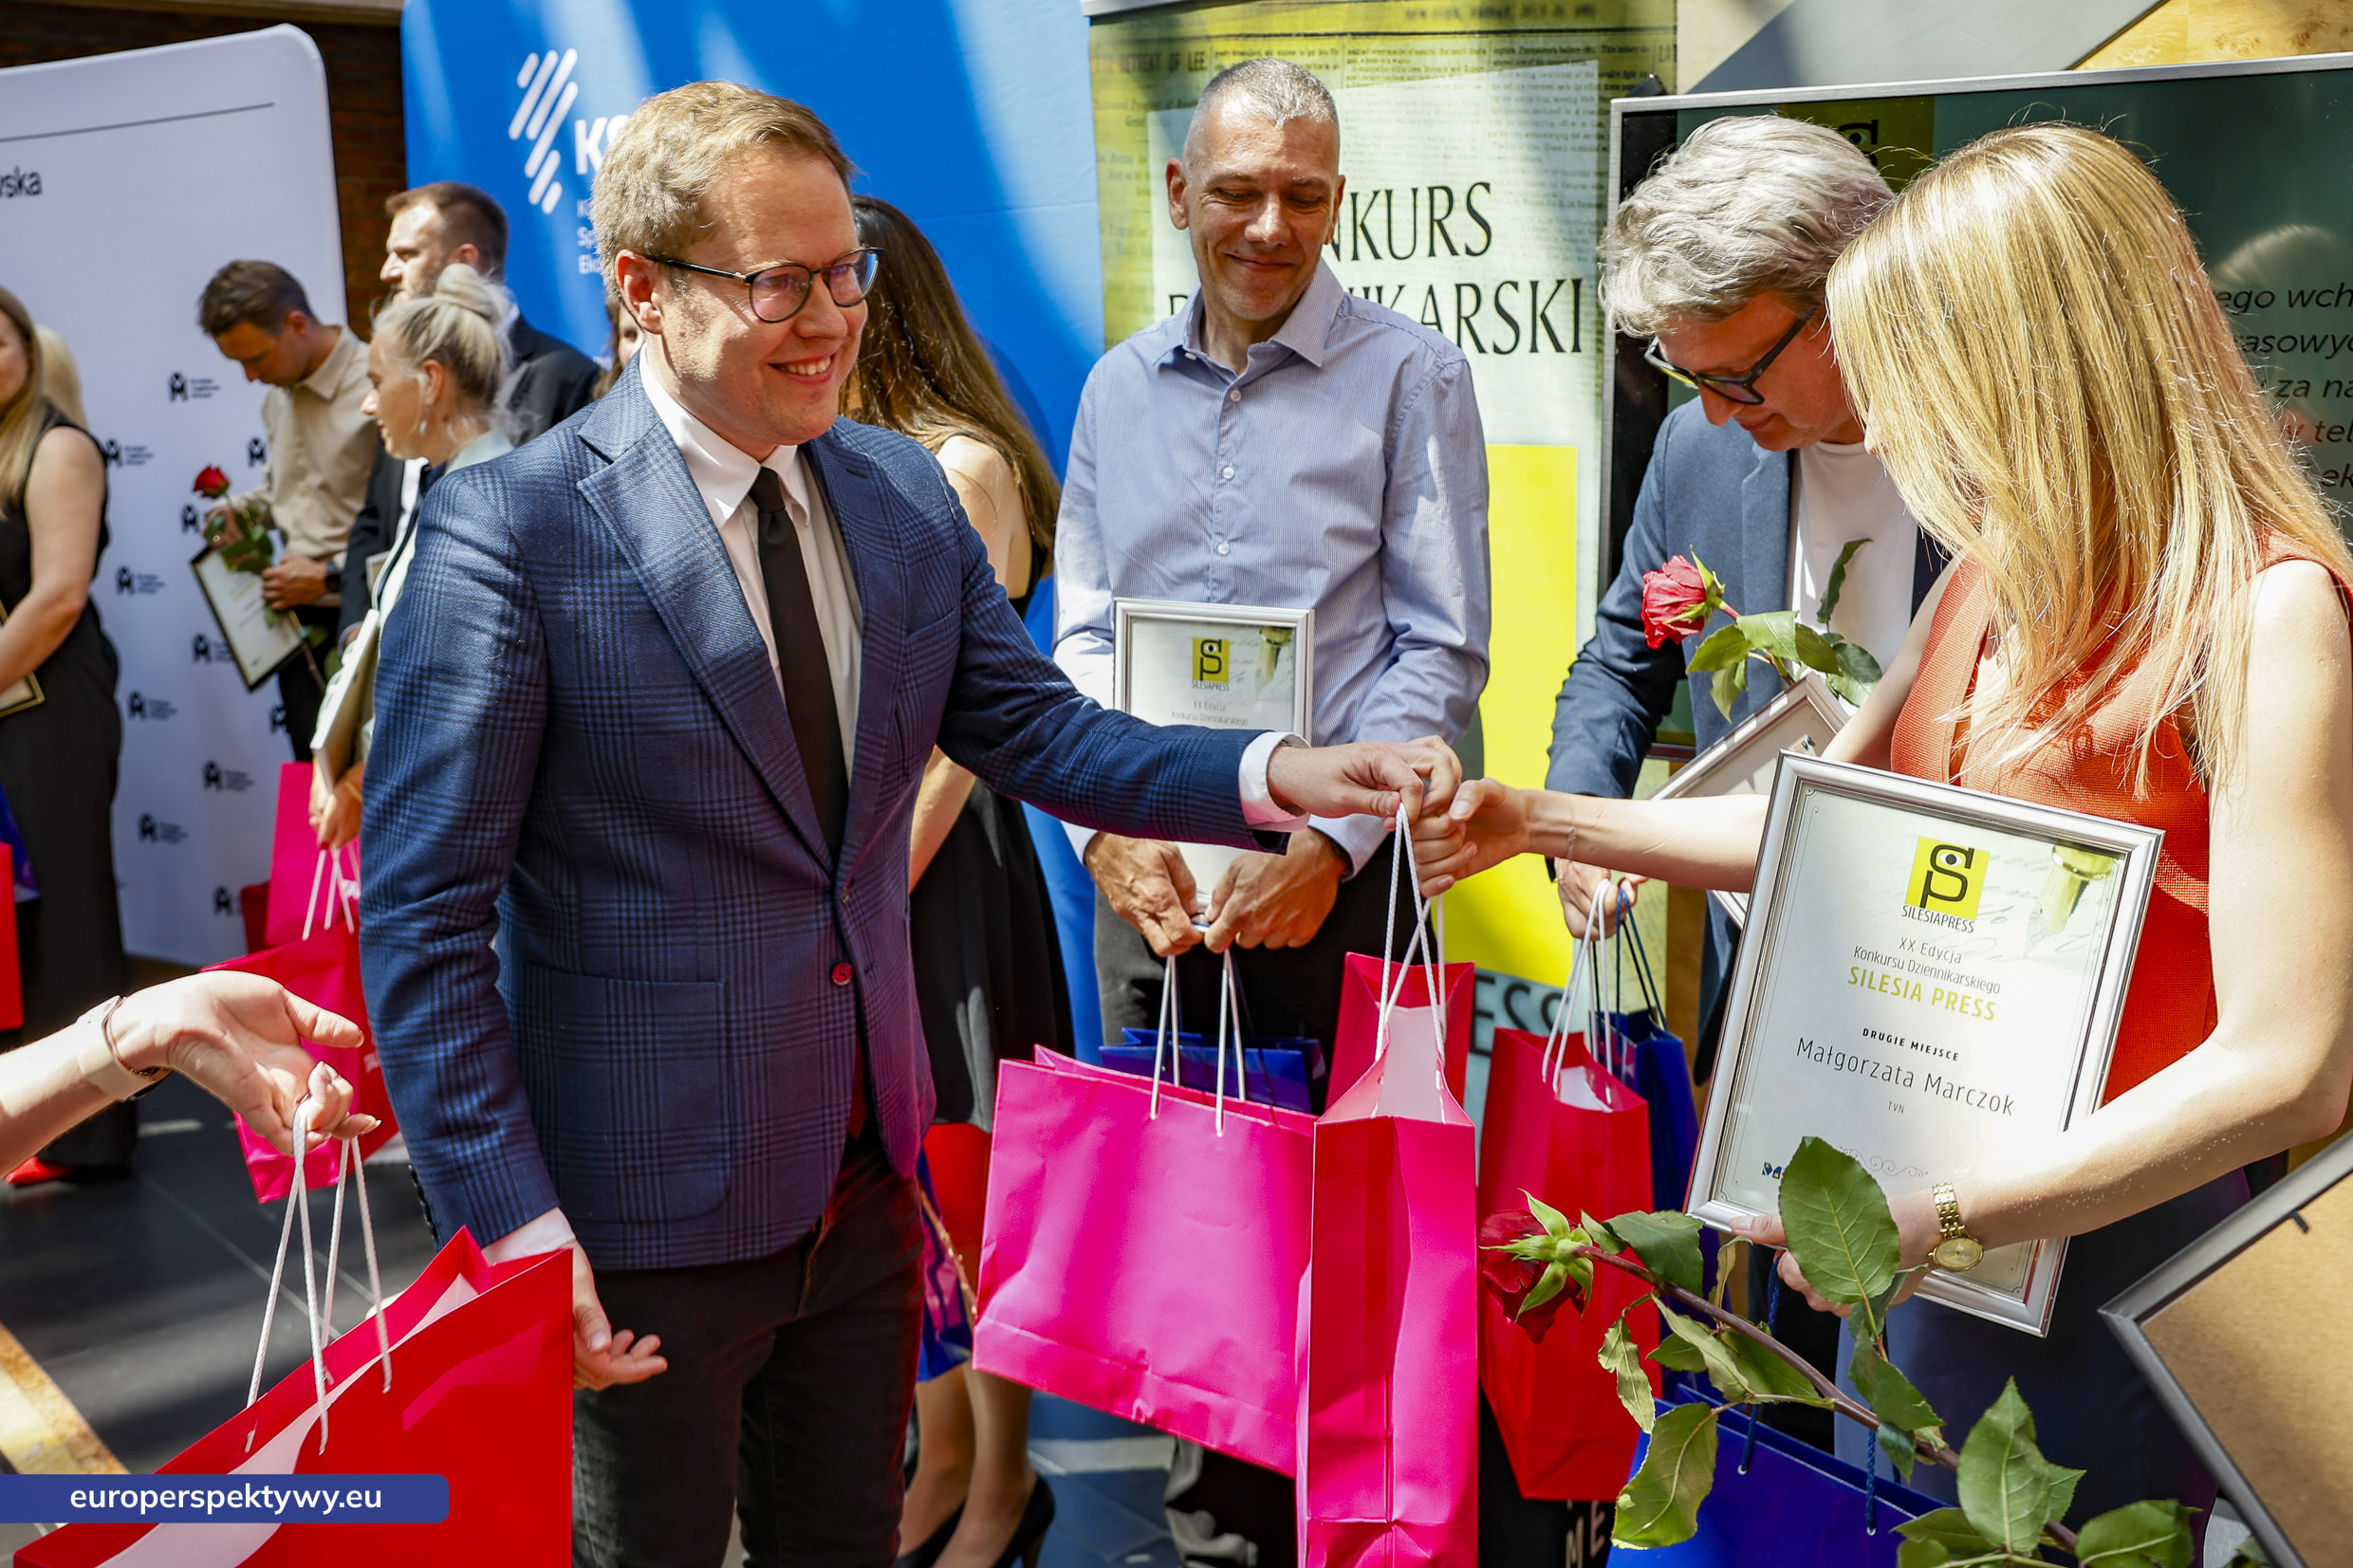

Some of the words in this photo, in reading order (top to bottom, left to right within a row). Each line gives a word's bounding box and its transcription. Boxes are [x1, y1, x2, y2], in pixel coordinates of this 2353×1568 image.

[2215, 289, 2276, 316] ego
[2275, 379, 2311, 397] za
[1901, 904, 1975, 933] SILESIAPRESS
[1899, 936, 1917, 952] XX
[1920, 942, 1962, 964] Edycja
[1853, 945, 1905, 969] Konkursu
[1907, 959, 2001, 995] Dziennikarskiego
[1847, 966, 1922, 1002] SILESIA
[1931, 987, 1997, 1021] PRESS
[1862, 1027, 1906, 1046] DRUGIE
[1910, 1041, 1960, 1061] MIEJSCE
[1796, 1037, 1916, 1088] Małgorzata
[1924, 1073, 2015, 1116] Marczok
[1887, 1100, 1905, 1115] TVN
